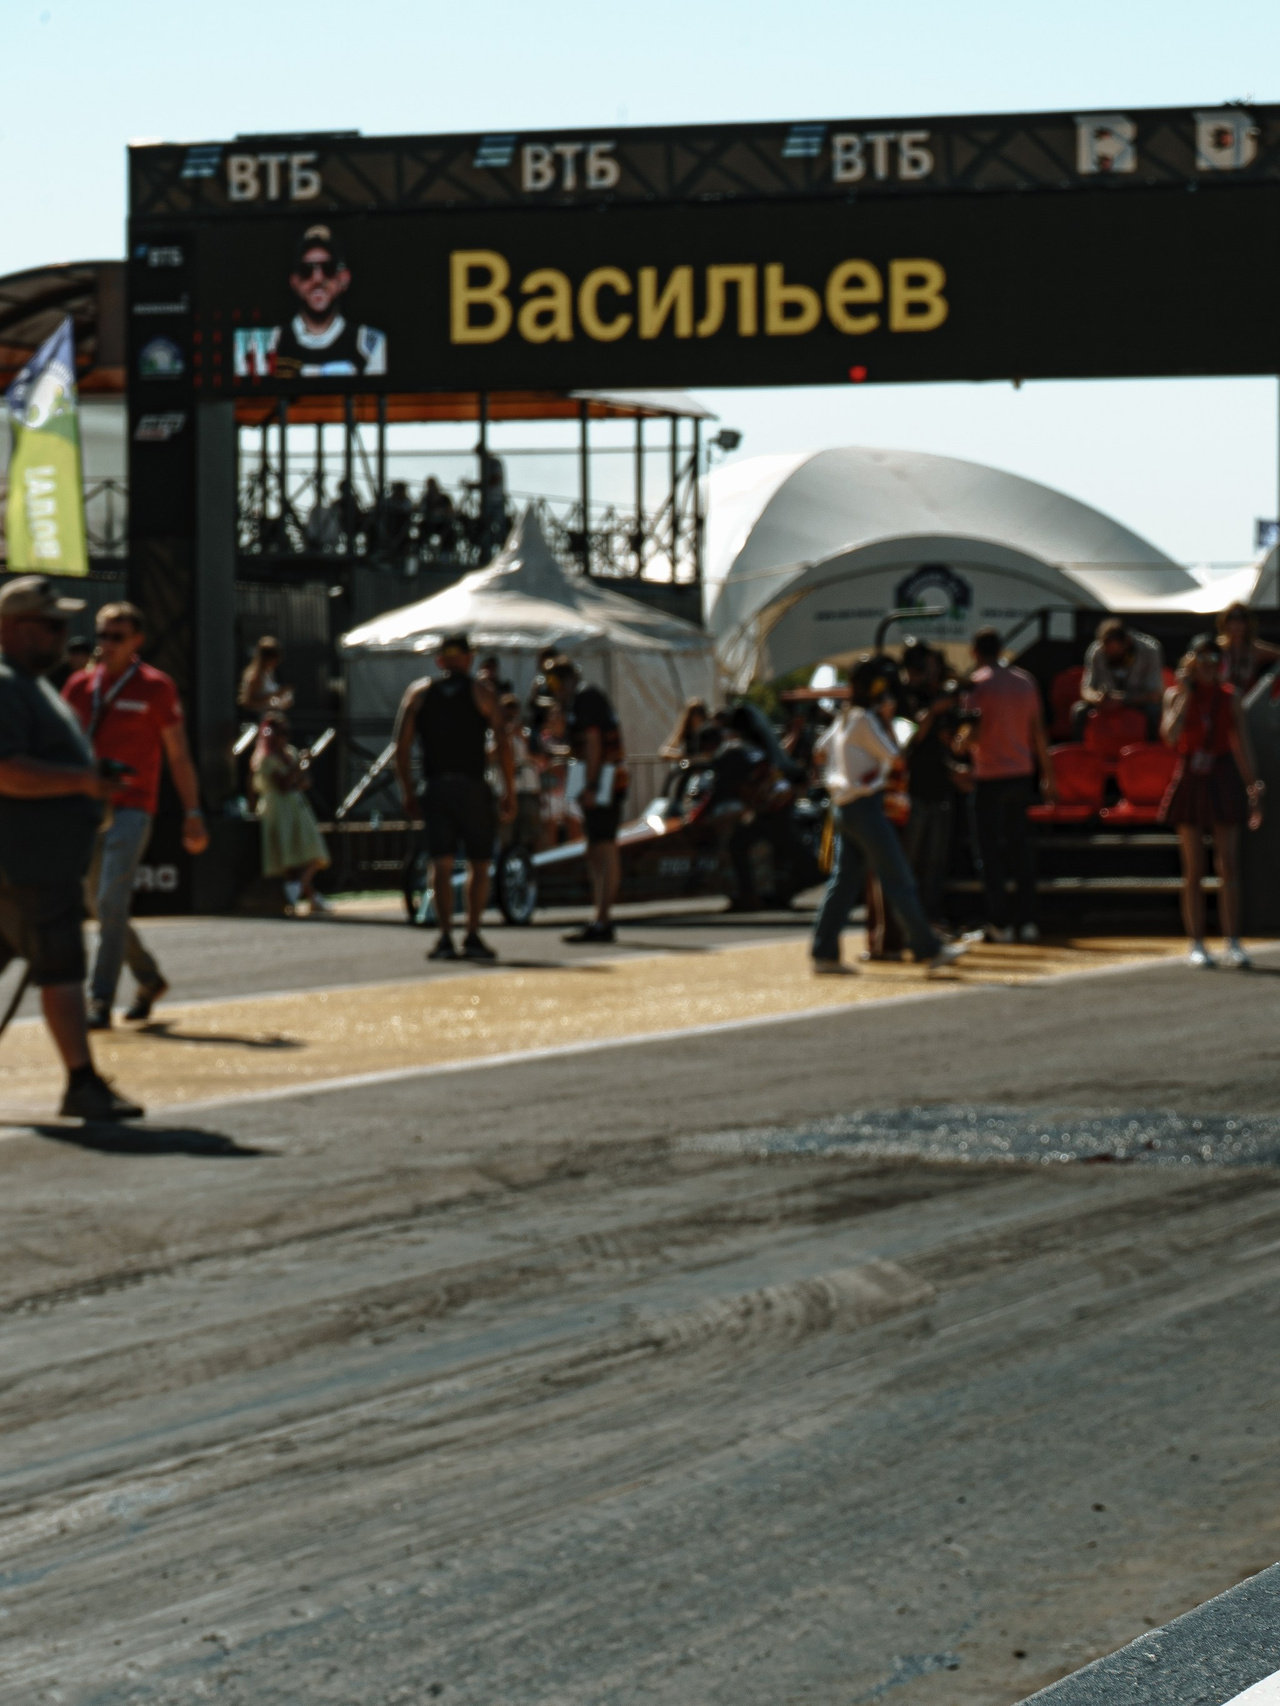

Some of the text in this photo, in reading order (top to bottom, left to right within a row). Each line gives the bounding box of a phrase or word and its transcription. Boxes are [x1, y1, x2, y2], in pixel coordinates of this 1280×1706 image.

[227, 152, 322, 200] ВТБ
[520, 141, 622, 191] ВТБ
[832, 130, 934, 182] ВТБ
[448, 249, 949, 345] Васильев
